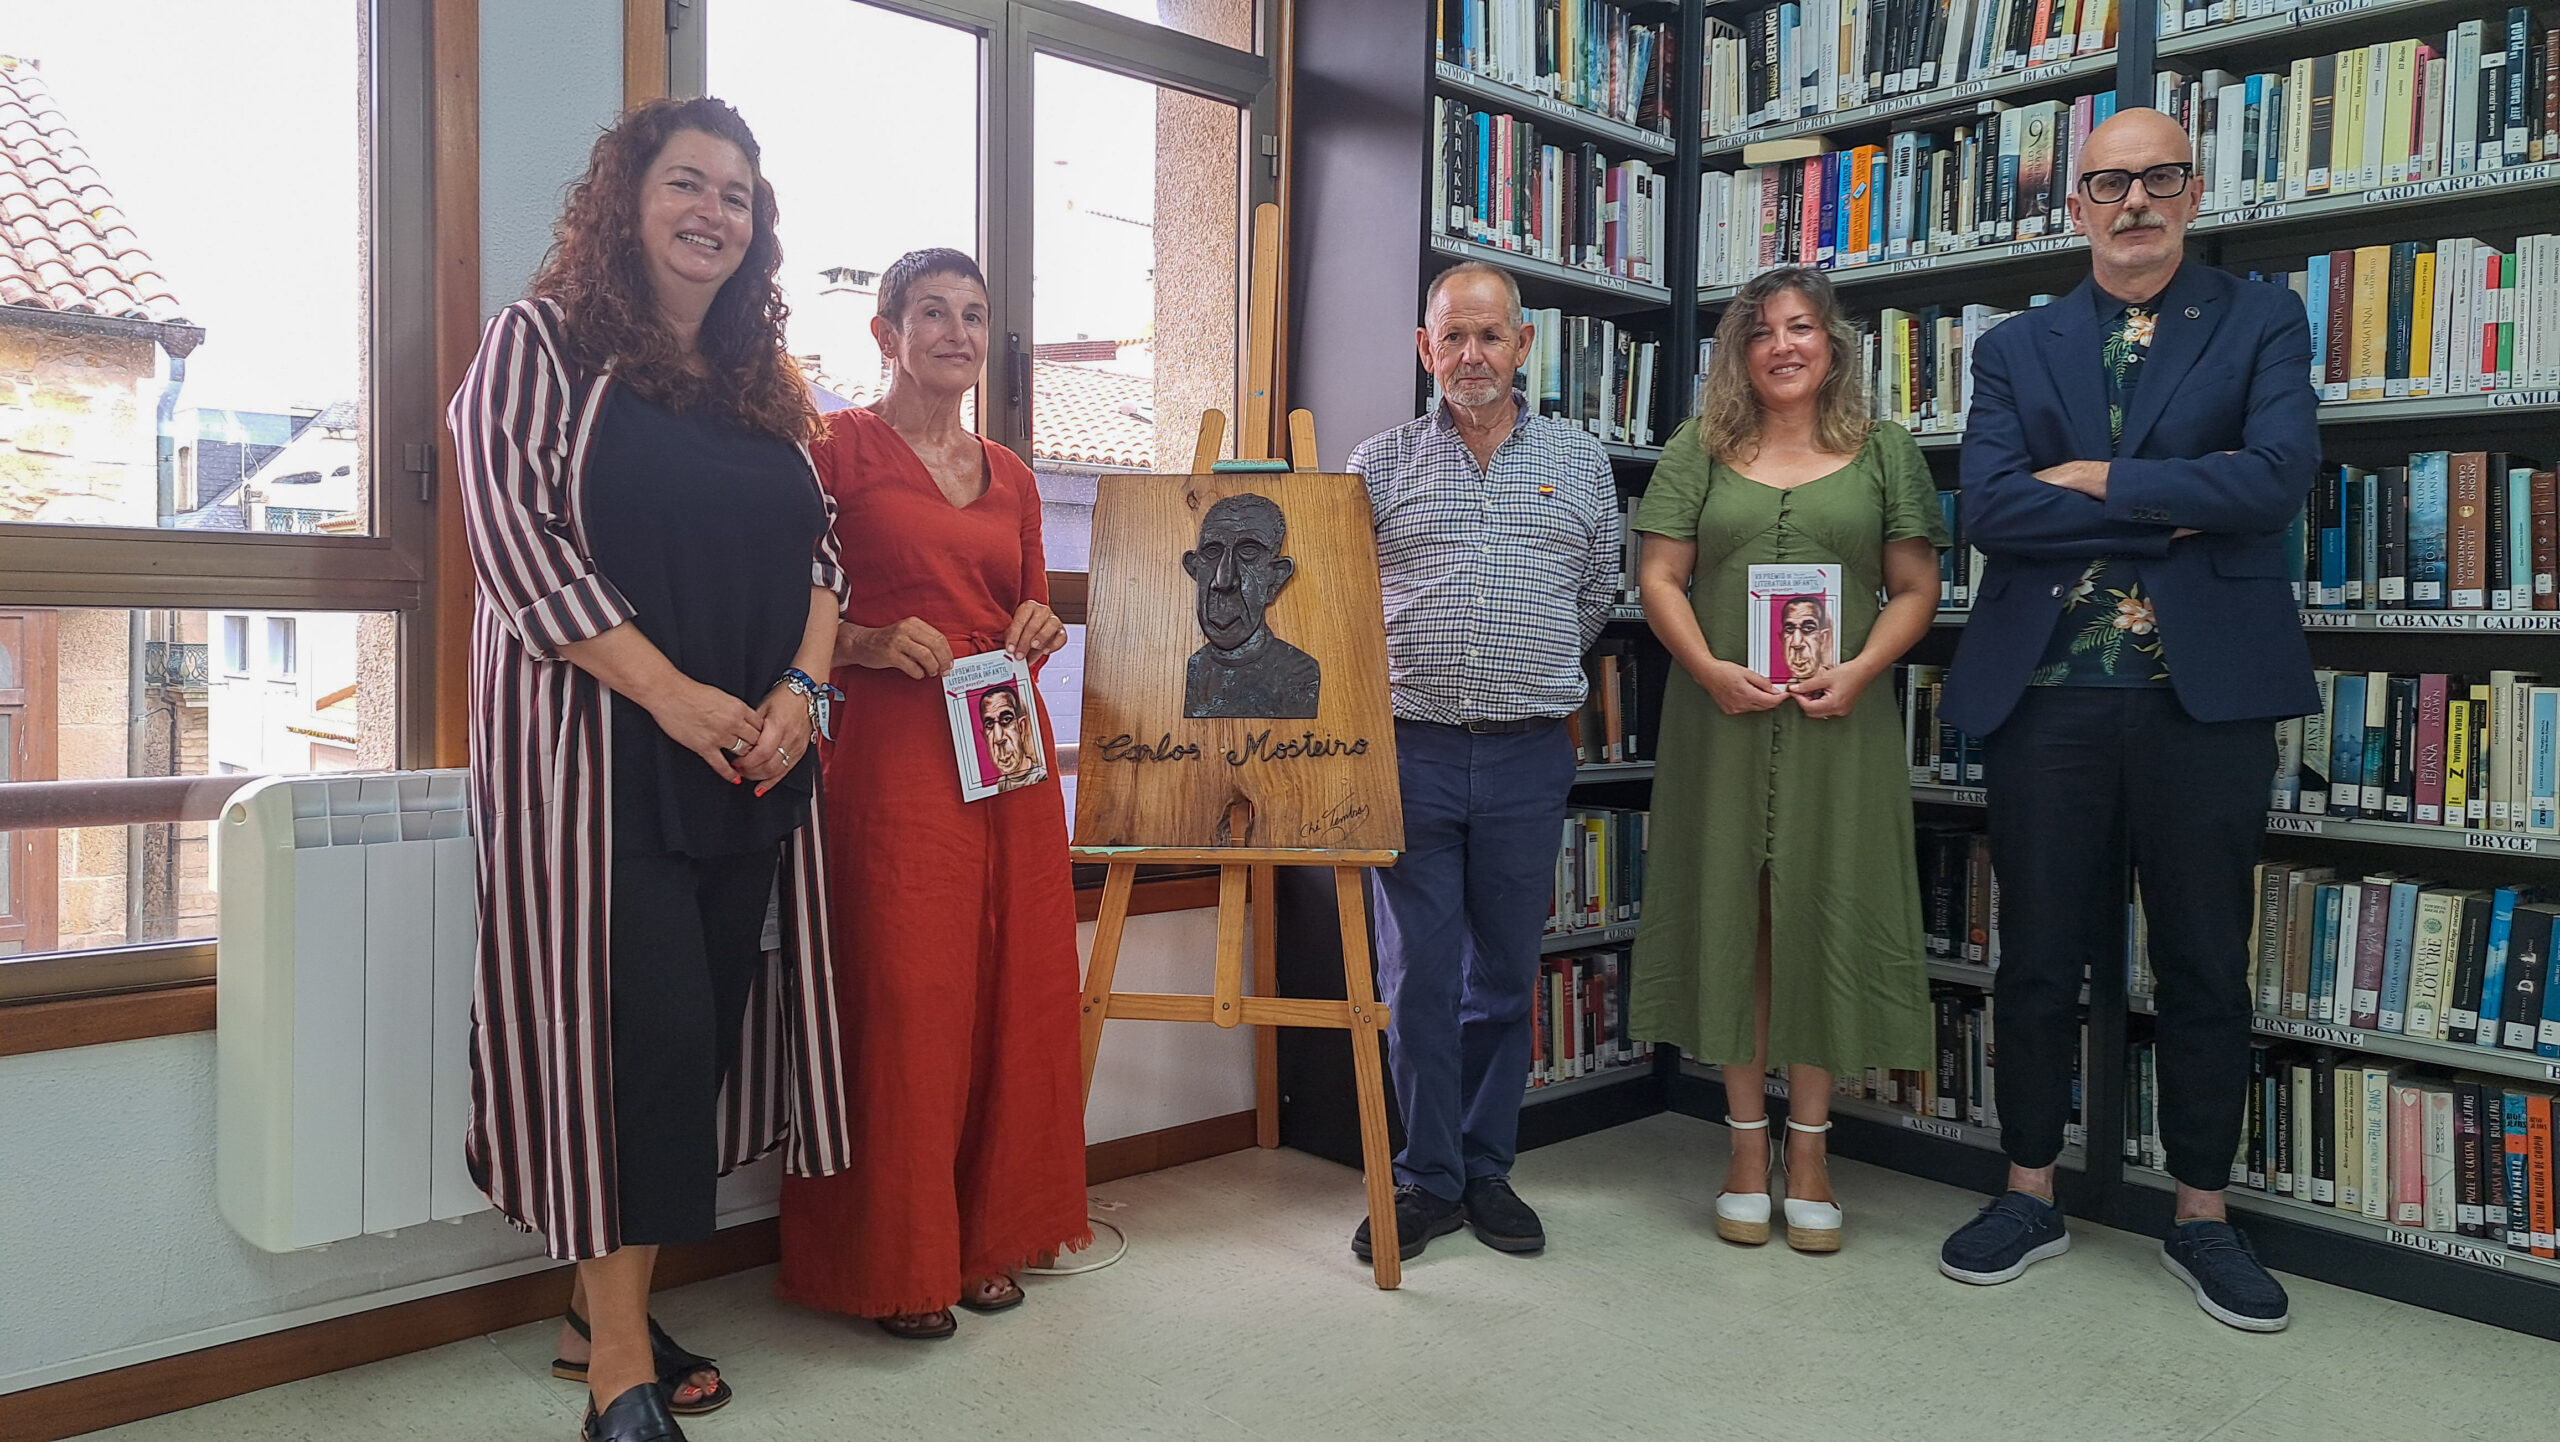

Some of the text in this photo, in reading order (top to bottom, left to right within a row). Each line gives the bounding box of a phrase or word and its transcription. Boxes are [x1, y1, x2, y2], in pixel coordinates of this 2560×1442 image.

[2289, 0, 2370, 23] CARROLL
[2341, 55, 2349, 69] Yoga
[2398, 45, 2406, 62] Reino
[1436, 63, 1471, 83] ASIMOV
[2023, 63, 2070, 83] BLACK
[2508, 21, 2524, 121] JEFF CARLSON LA PLAGA
[1956, 81, 1985, 97] BIOY
[1874, 95, 1922, 115] BIEDMA
[2296, 103, 2301, 111] un
[1796, 114, 1834, 132] BERRY
[1717, 131, 1760, 149] BERGER
[2293, 127, 2301, 153] Conviene
[1453, 119, 1463, 204] KRAKE
[1898, 146, 1910, 177] MUNDO
[2423, 165, 2546, 195] CARPENTIER
[2366, 185, 2416, 203] CARD
[2221, 205, 2285, 224] CAPOTE
[1433, 235, 1462, 252] ARIZA
[1893, 258, 1934, 273] BENET
[2369, 257, 2377, 281] POYATO
[2339, 284, 2347, 305] CALVO
[2331, 307, 2344, 379] LA RUTA INFINITA
[2361, 305, 2373, 377] LA TRAVESÍA FINAL
[2517, 322, 2525, 356] MONTALBANO
[2535, 332, 2543, 364] MONTALBANO
[2416, 470, 2425, 515] ANTONIO
[2429, 470, 2438, 513] CABANAS
[2458, 464, 2467, 500] CABANAS
[2467, 462, 2476, 501] ANTONIO
[2416, 546, 2424, 570] CAMINO
[2424, 531, 2436, 574] DIOSES
[2456, 524, 2467, 586] TUTANKHAMÓN
[2466, 530, 2476, 580] EL SUEÑO DE
[1754, 579, 1819, 588] LITERATURA INFANTIL
[2379, 614, 2464, 628] CABANAS
[948, 666, 1008, 686] LITERATURA INFANTIL
[2422, 695, 2431, 721] NICK
[2430, 689, 2441, 728] BROWN
[2515, 686, 2524, 743] Reo de nocturnidad
[1096, 729, 1369, 766] Carlos Mosteiro
[2306, 727, 2318, 752] DAN
[2449, 705, 2464, 779] GUERRA MUNDIAL Z
[2278, 744, 2287, 780] ORIGEN
[2419, 768, 2427, 782] UNA
[2422, 743, 2440, 786] LEJANA
[2469, 833, 2532, 851] BRYCE
[2264, 874, 2280, 963] EL TESTAMENTO FINAL
[2367, 889, 2380, 923] John Boyne
[2447, 898, 2461, 963] Esta salvaje oscuridad
[2392, 938, 2403, 961] NIEVE
[2413, 946, 2428, 998] LA PROFECÍA
[2422, 938, 2442, 999] LOUVRE
[2304, 1025, 2361, 1046] BOYNE
[2367, 1089, 2382, 1137] BLUE JEANS
[2489, 1099, 2502, 1138] BLUE JEANS
[1910, 1121, 1959, 1139] AUSTER
[2279, 1149, 2287, 1173] WILLIAM
[2463, 1094, 2476, 1204] PUZLE DE CRISTAL BLUE JEANS
[2533, 1135, 2545, 1160] CHOPIN
[2534, 1161, 2545, 1170] DE
[2511, 1160, 2524, 1231] EL CAMPAMENTO
[2533, 1171, 2545, 1199] MELODÍA
[2534, 1200, 2545, 1224] ÚLTIMA
[2391, 1231, 2502, 1267] BLUE JEANS
